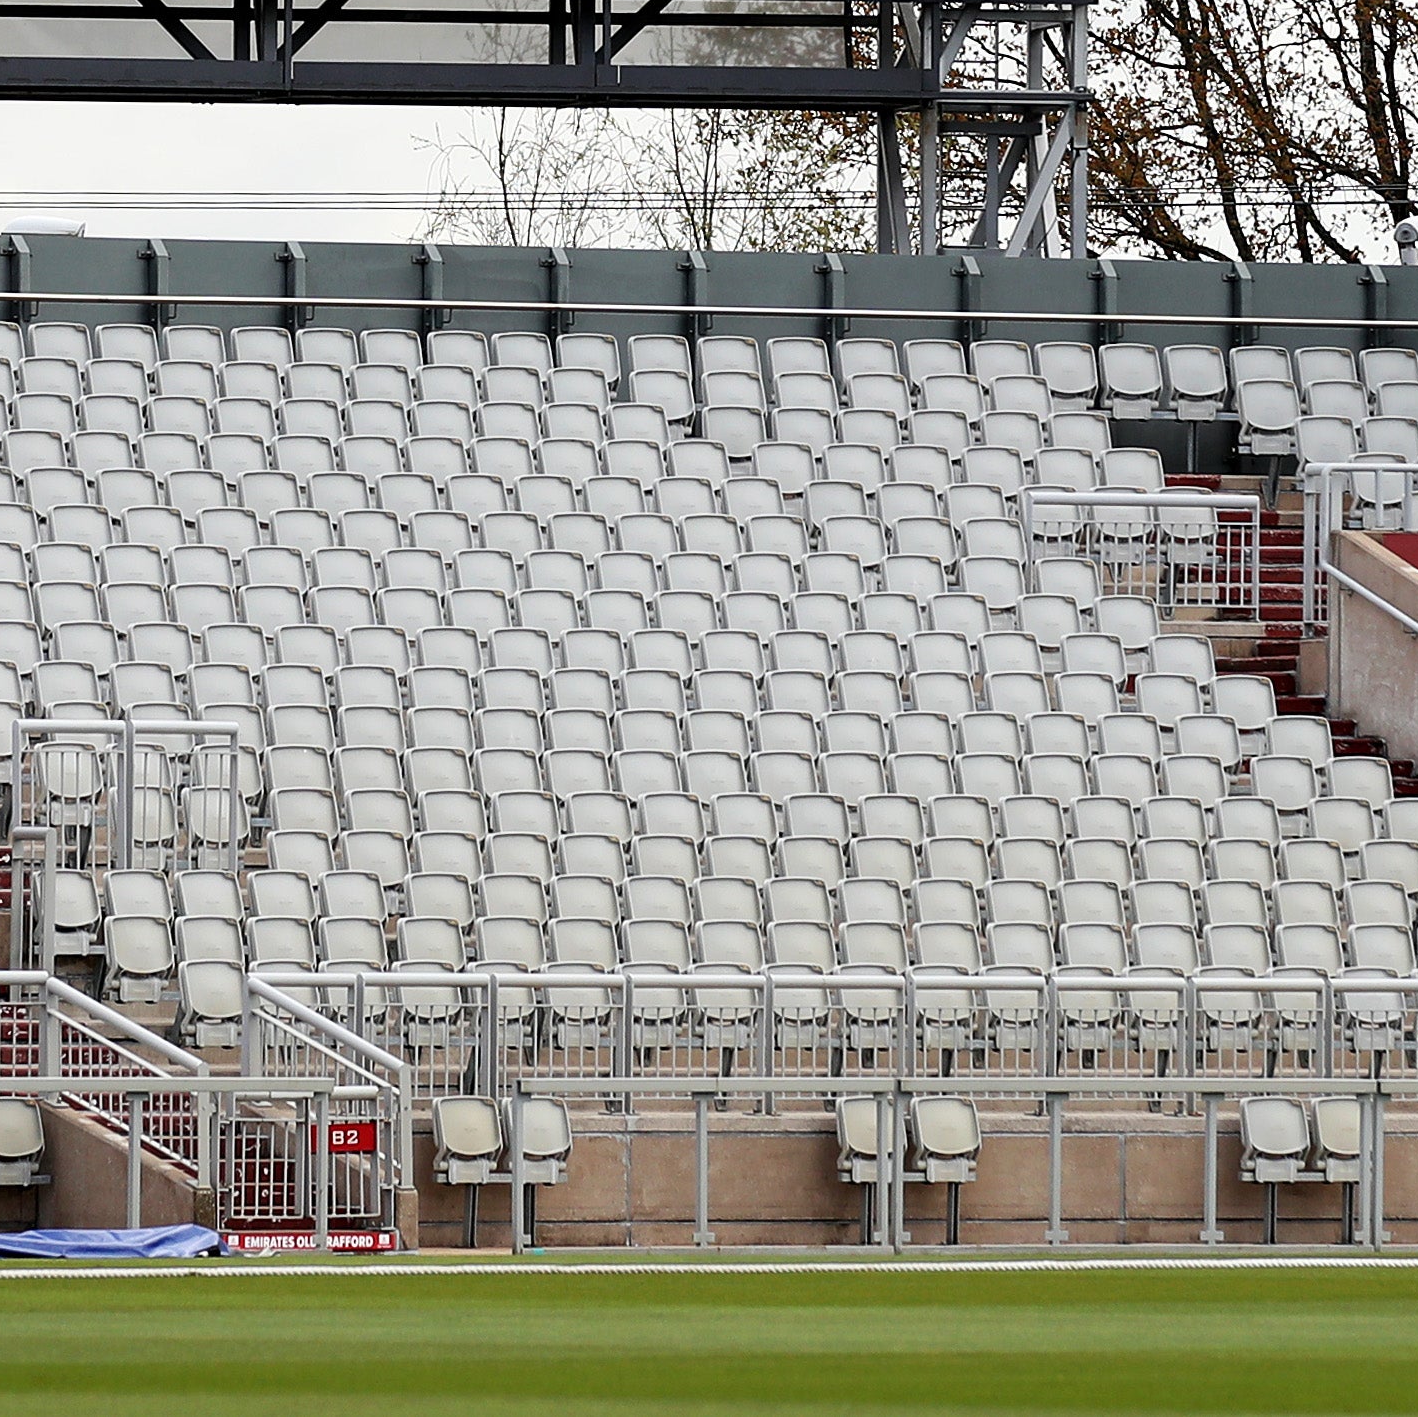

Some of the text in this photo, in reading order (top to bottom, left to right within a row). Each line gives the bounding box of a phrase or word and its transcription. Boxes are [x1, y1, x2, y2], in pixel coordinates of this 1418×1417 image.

[332, 1129, 359, 1145] B2
[244, 1235, 295, 1248] EMIRATES
[326, 1234, 374, 1248] RAFFORD
